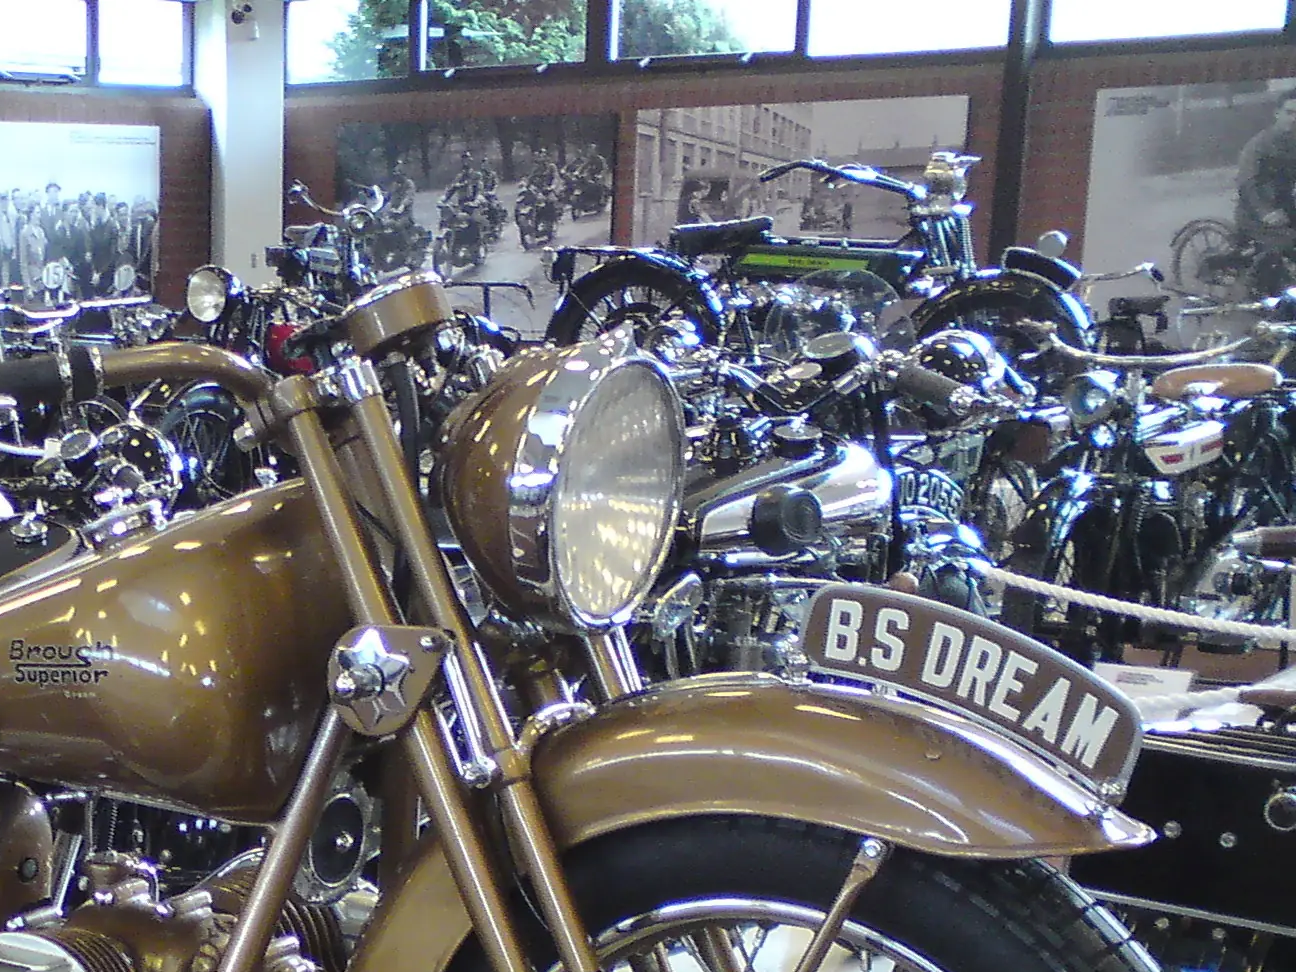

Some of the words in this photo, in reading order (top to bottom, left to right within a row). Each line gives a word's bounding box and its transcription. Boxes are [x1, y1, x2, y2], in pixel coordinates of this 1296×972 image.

[9, 639, 114, 668] Brough
[15, 664, 109, 688] Superior
[921, 621, 1120, 770] DREAM
